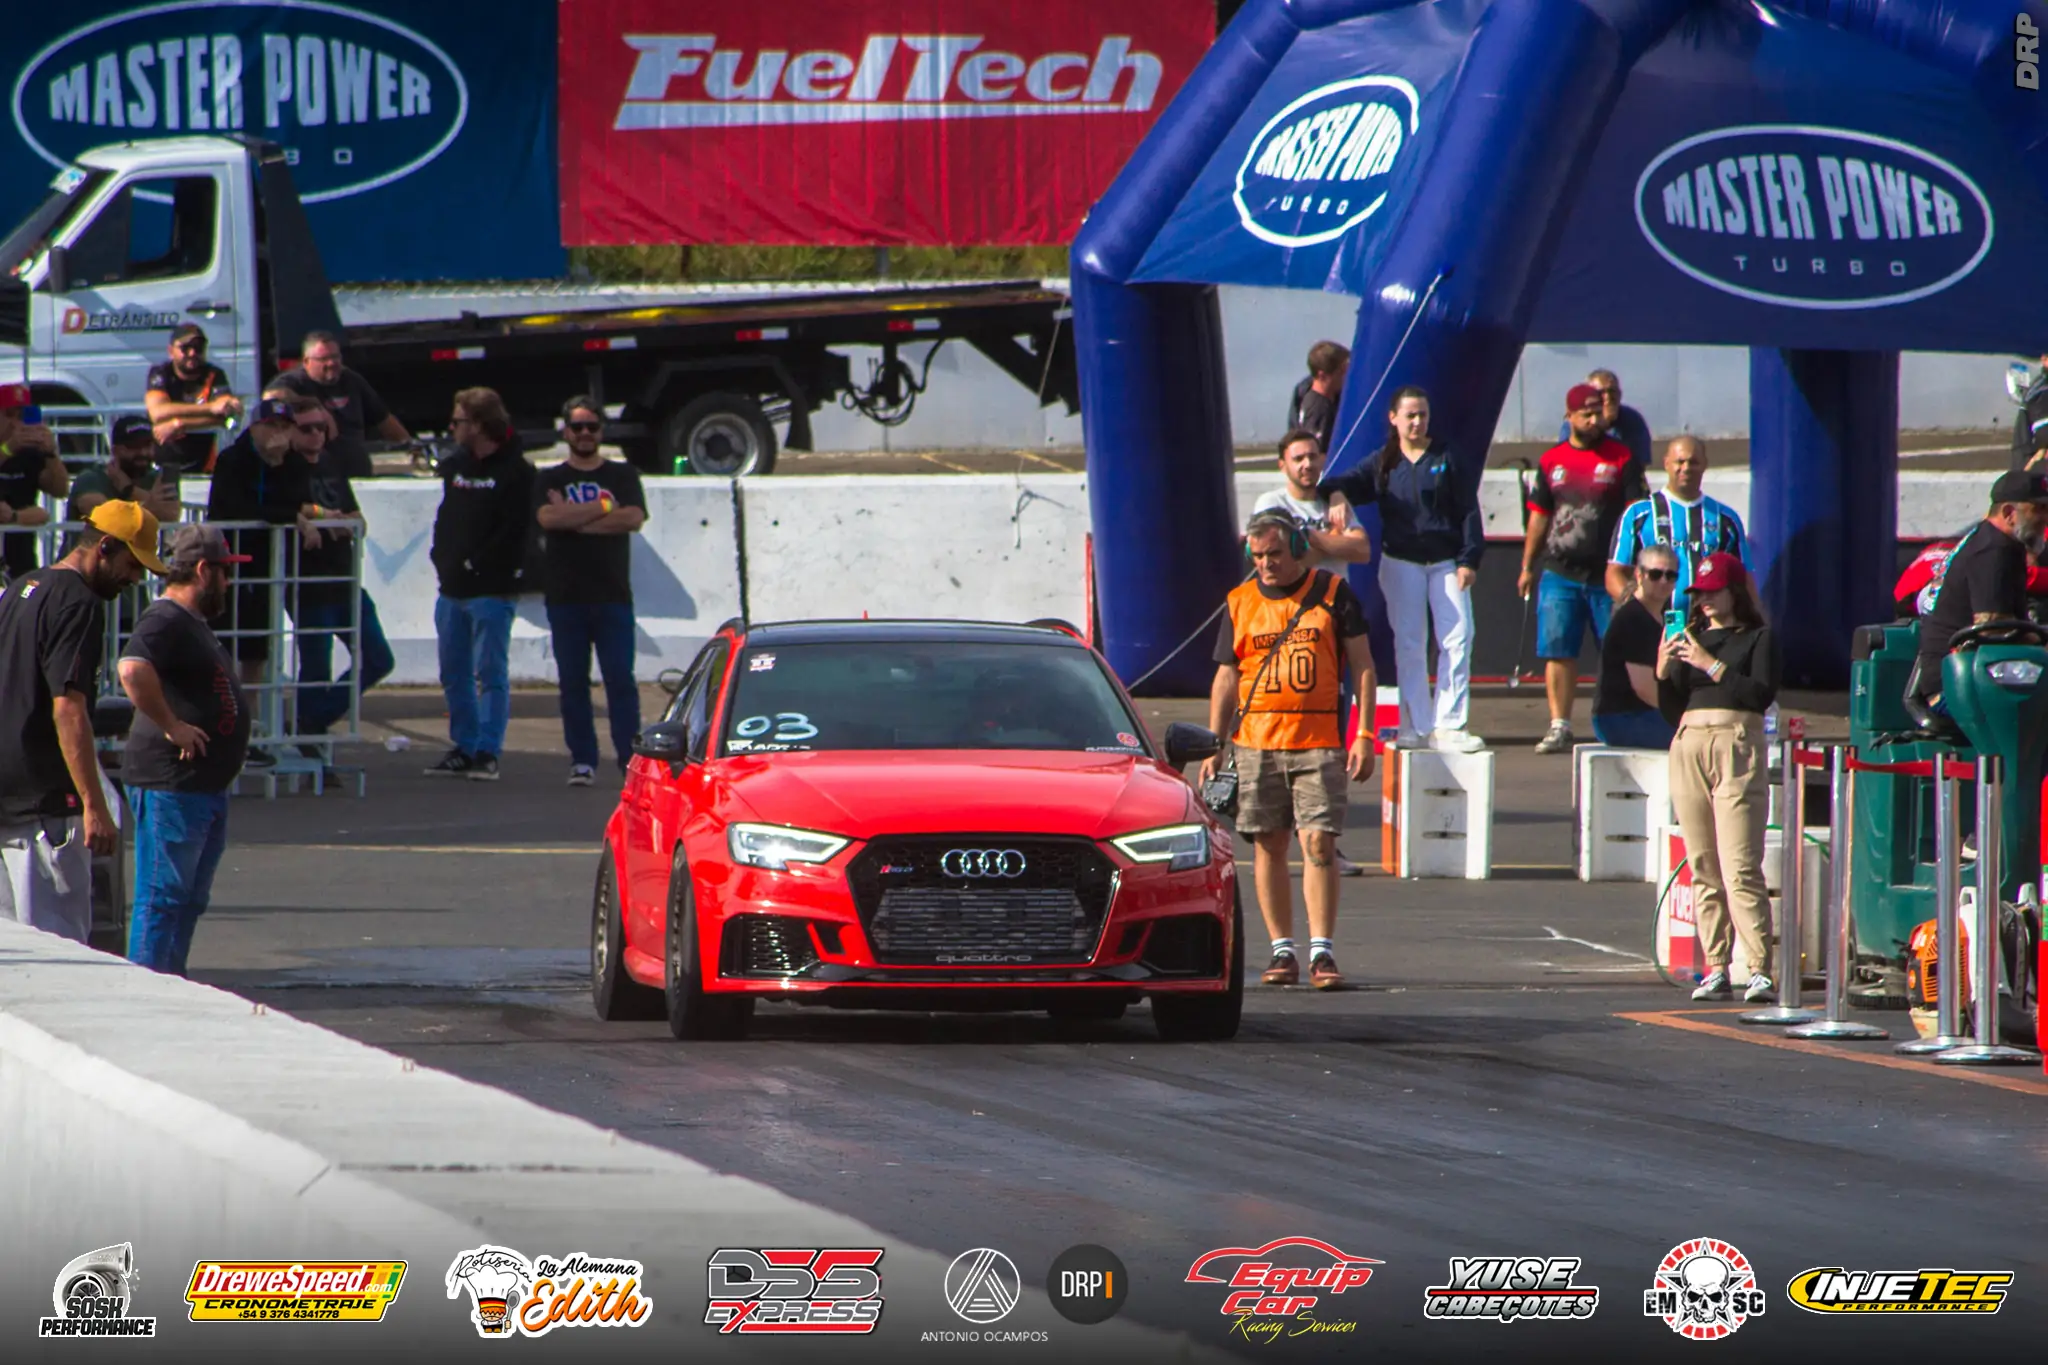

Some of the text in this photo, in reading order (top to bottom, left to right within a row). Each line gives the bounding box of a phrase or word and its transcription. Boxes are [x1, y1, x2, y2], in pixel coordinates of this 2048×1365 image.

[50, 33, 431, 130] MASTER POWER
[1662, 154, 1962, 240] MASTER POWER
[1734, 256, 1906, 277] TURBO
[1253, 628, 1320, 649] IMPENSA
[1260, 647, 1316, 693] 10
[736, 712, 819, 740] 03
[936, 952, 1032, 964] quattro
